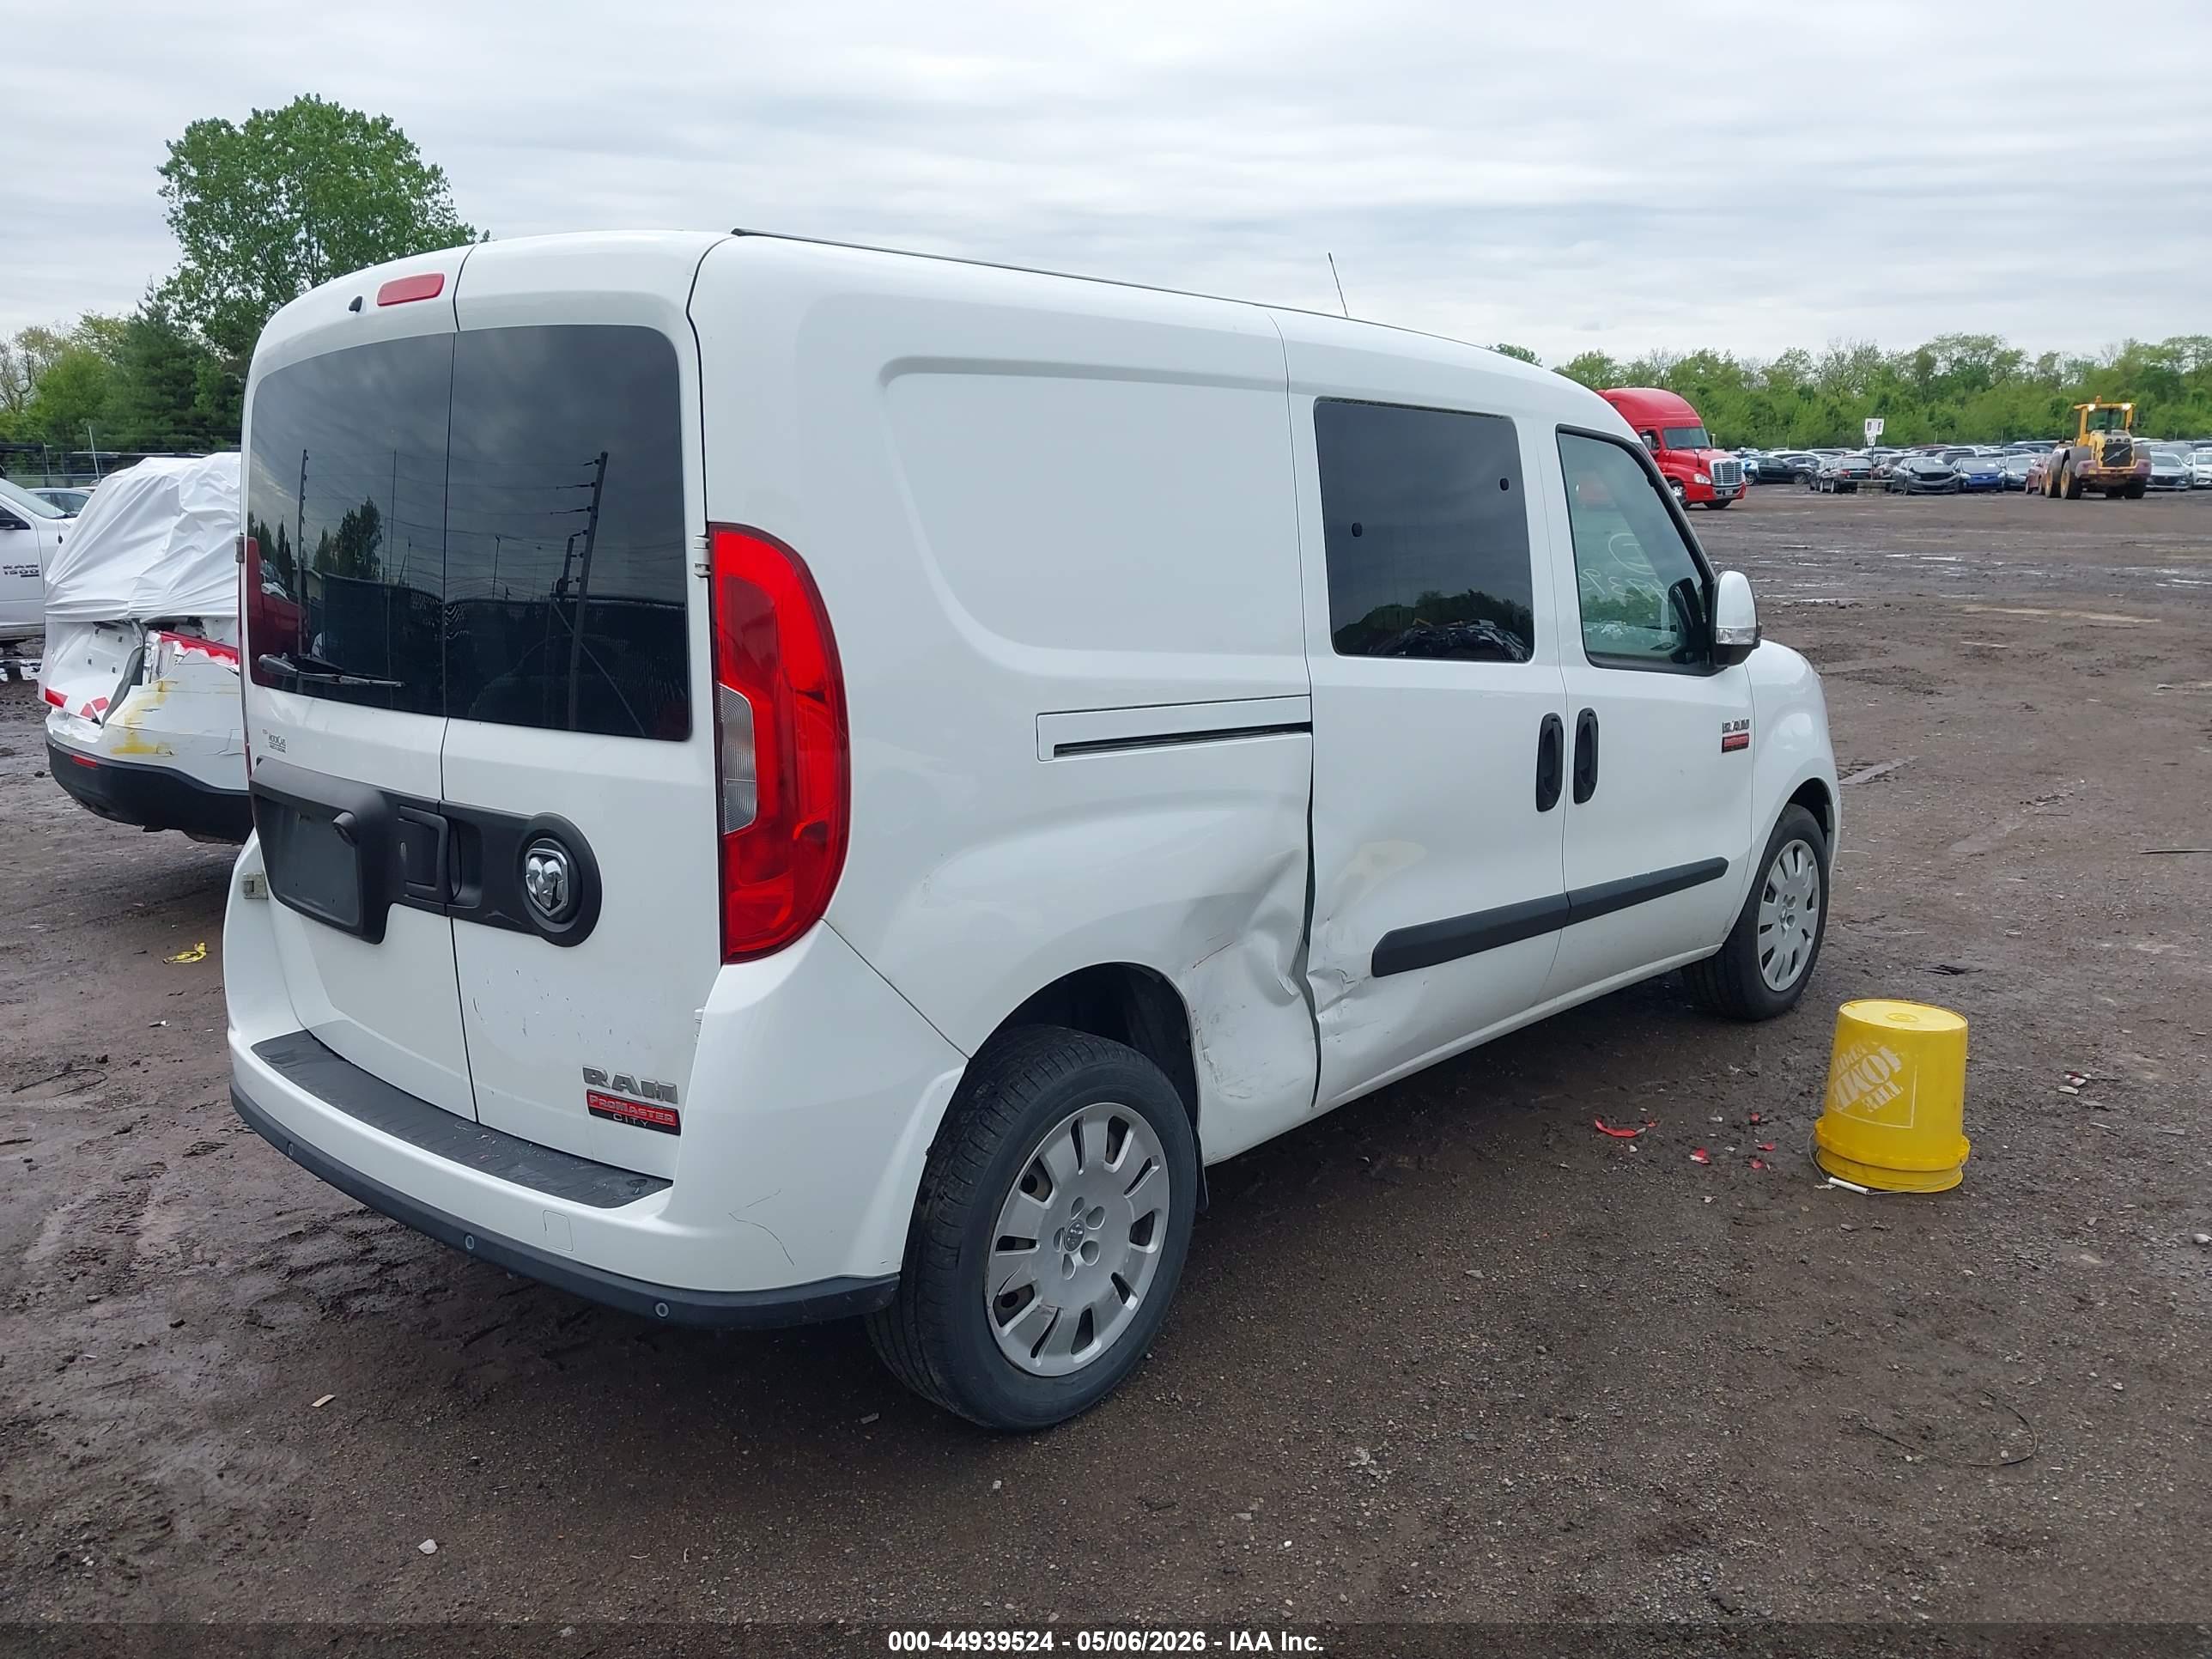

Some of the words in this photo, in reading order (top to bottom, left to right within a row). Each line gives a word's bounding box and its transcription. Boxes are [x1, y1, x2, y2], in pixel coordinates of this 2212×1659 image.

[1722, 719, 1750, 733] RAM
[582, 1066, 678, 1105] RAM
[612, 1113, 649, 1127] CITY
